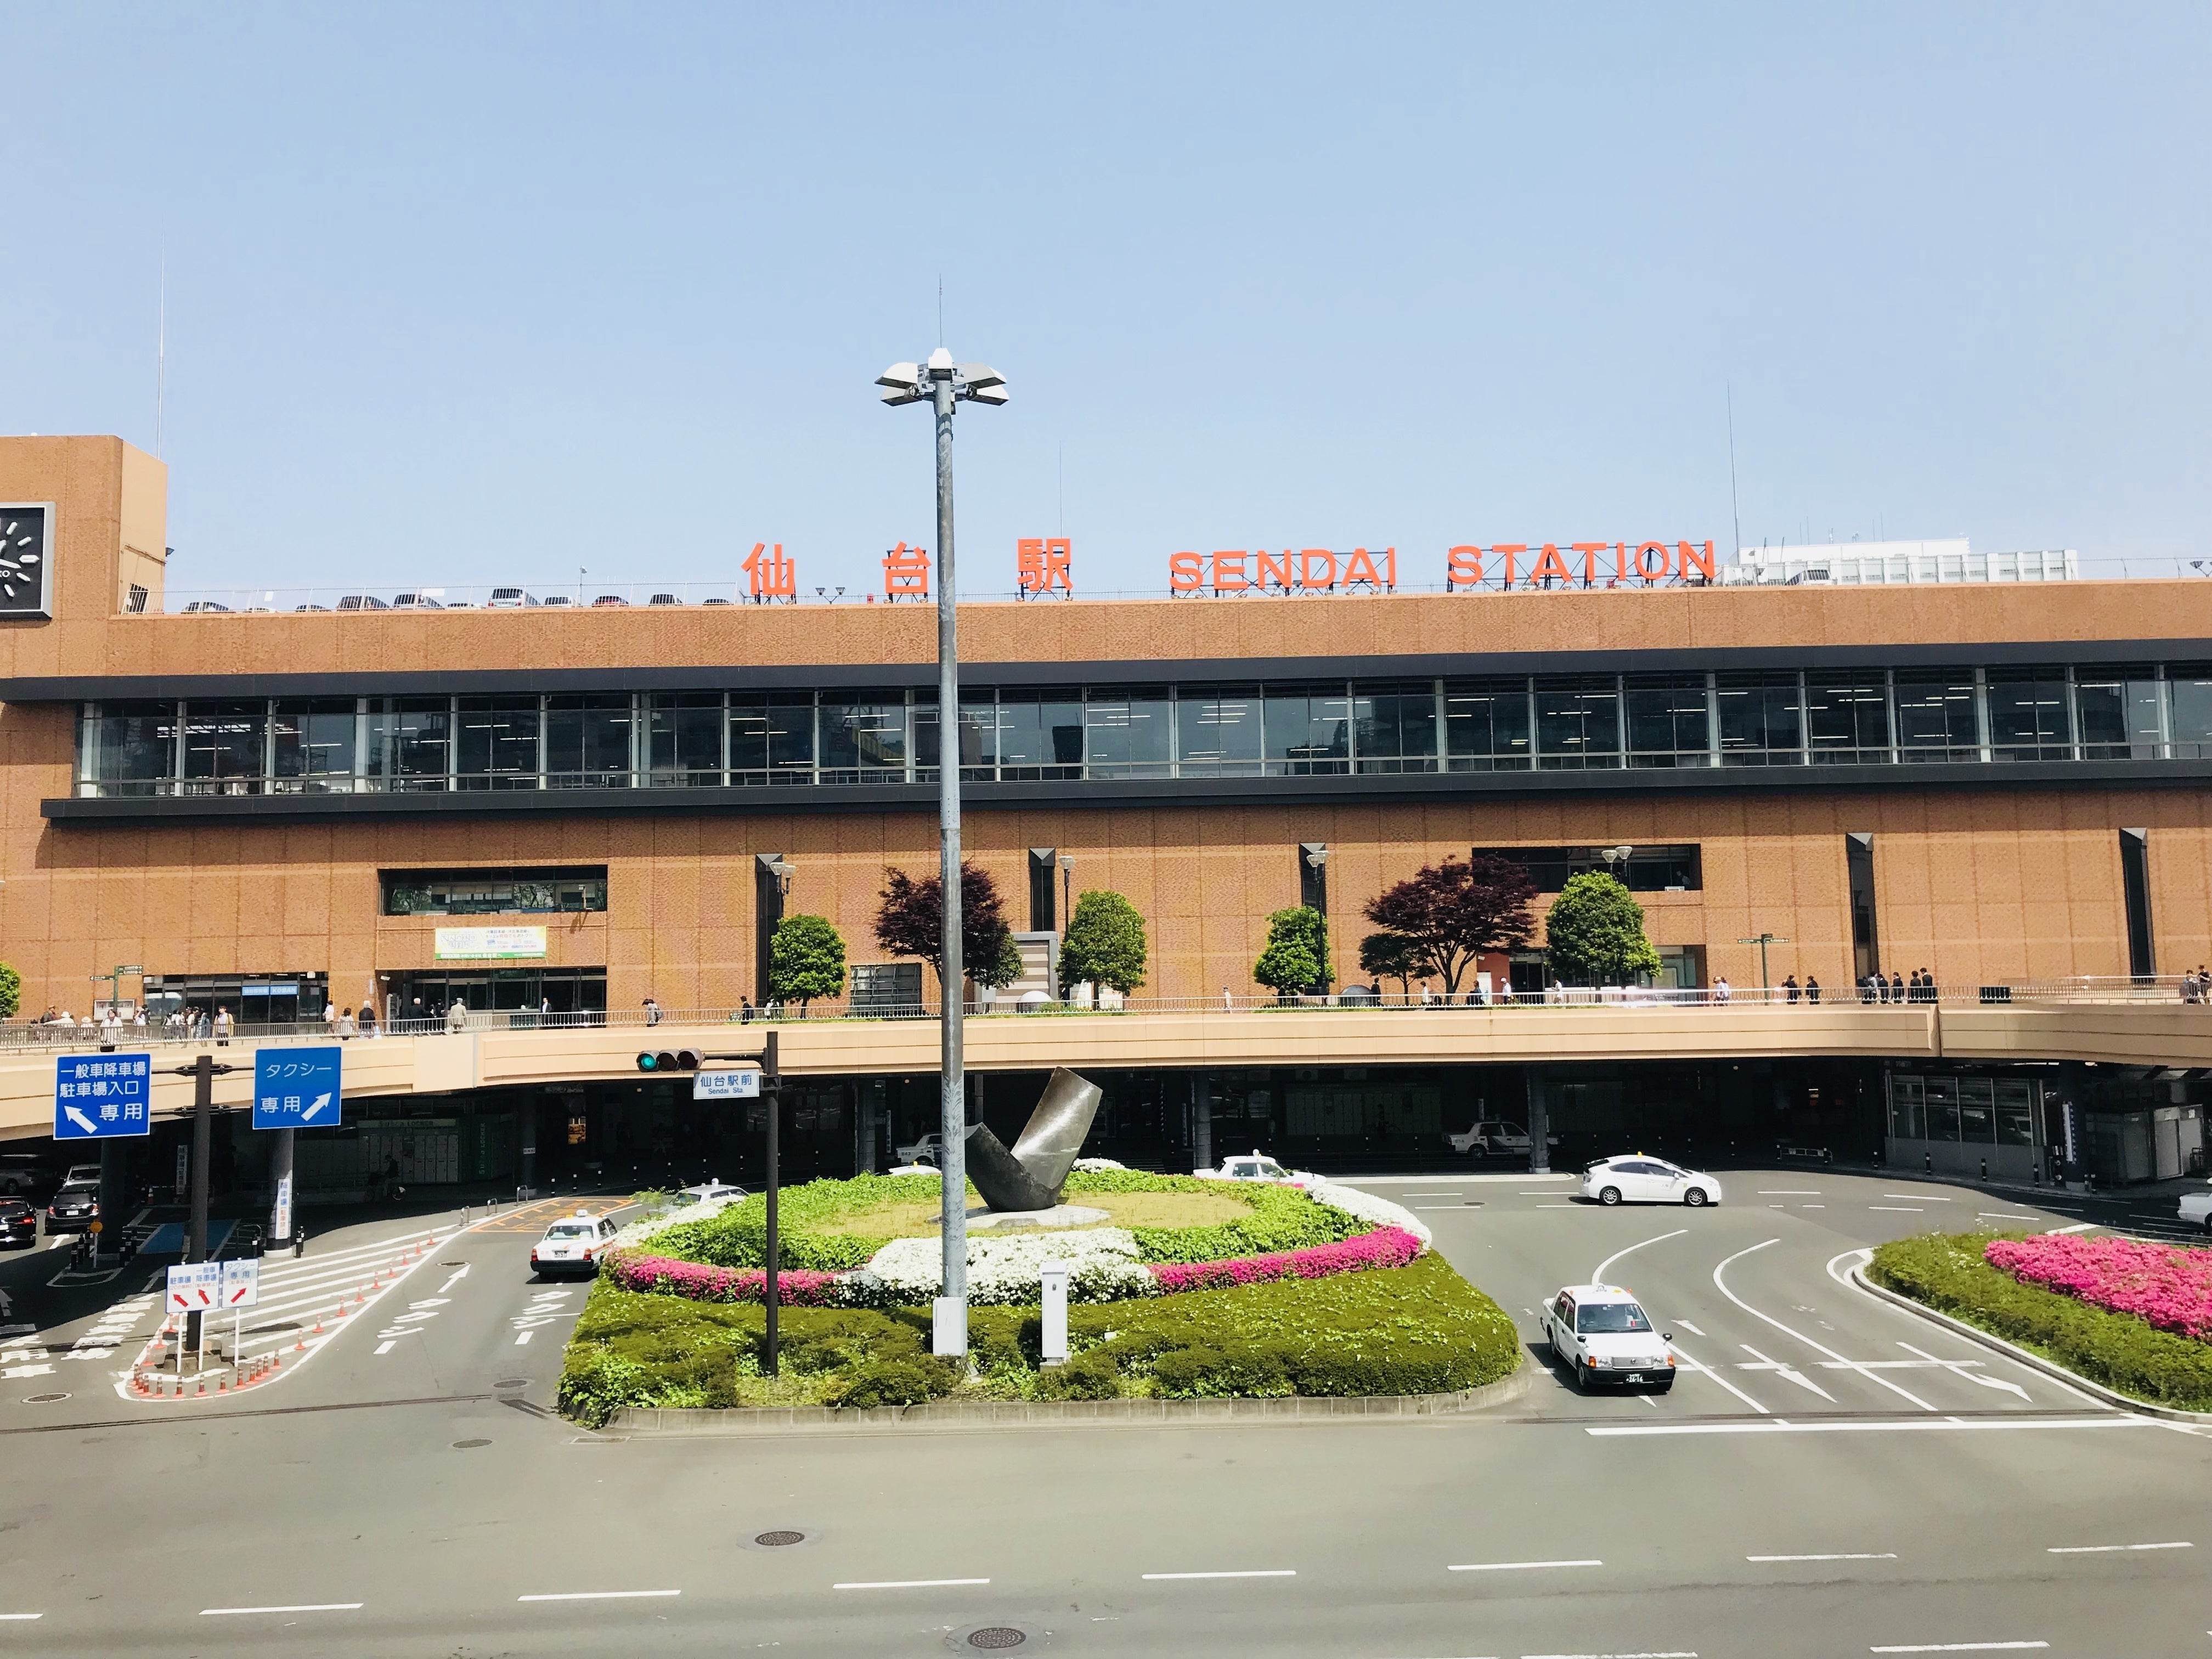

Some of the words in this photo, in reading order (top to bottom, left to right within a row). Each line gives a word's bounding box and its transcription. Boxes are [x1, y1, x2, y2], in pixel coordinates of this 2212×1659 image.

[743, 539, 1071, 595] 仙台駅
[1170, 549, 1395, 590] SENDAI
[1449, 541, 1714, 584] STATION
[60, 1062, 146, 1079] 一般車降車場
[266, 1063, 331, 1078] タクシー
[701, 1074, 752, 1087] 仙台駅前
[59, 1081, 138, 1098] 駐車場入口
[99, 1103, 143, 1121] 専用
[261, 1096, 300, 1113] 専用
[226, 1262, 255, 1271] タクシー
[170, 1276, 191, 1285] 駐車場
[196, 1274, 217, 1282] 降車場
[230, 1271, 251, 1279] 専用
